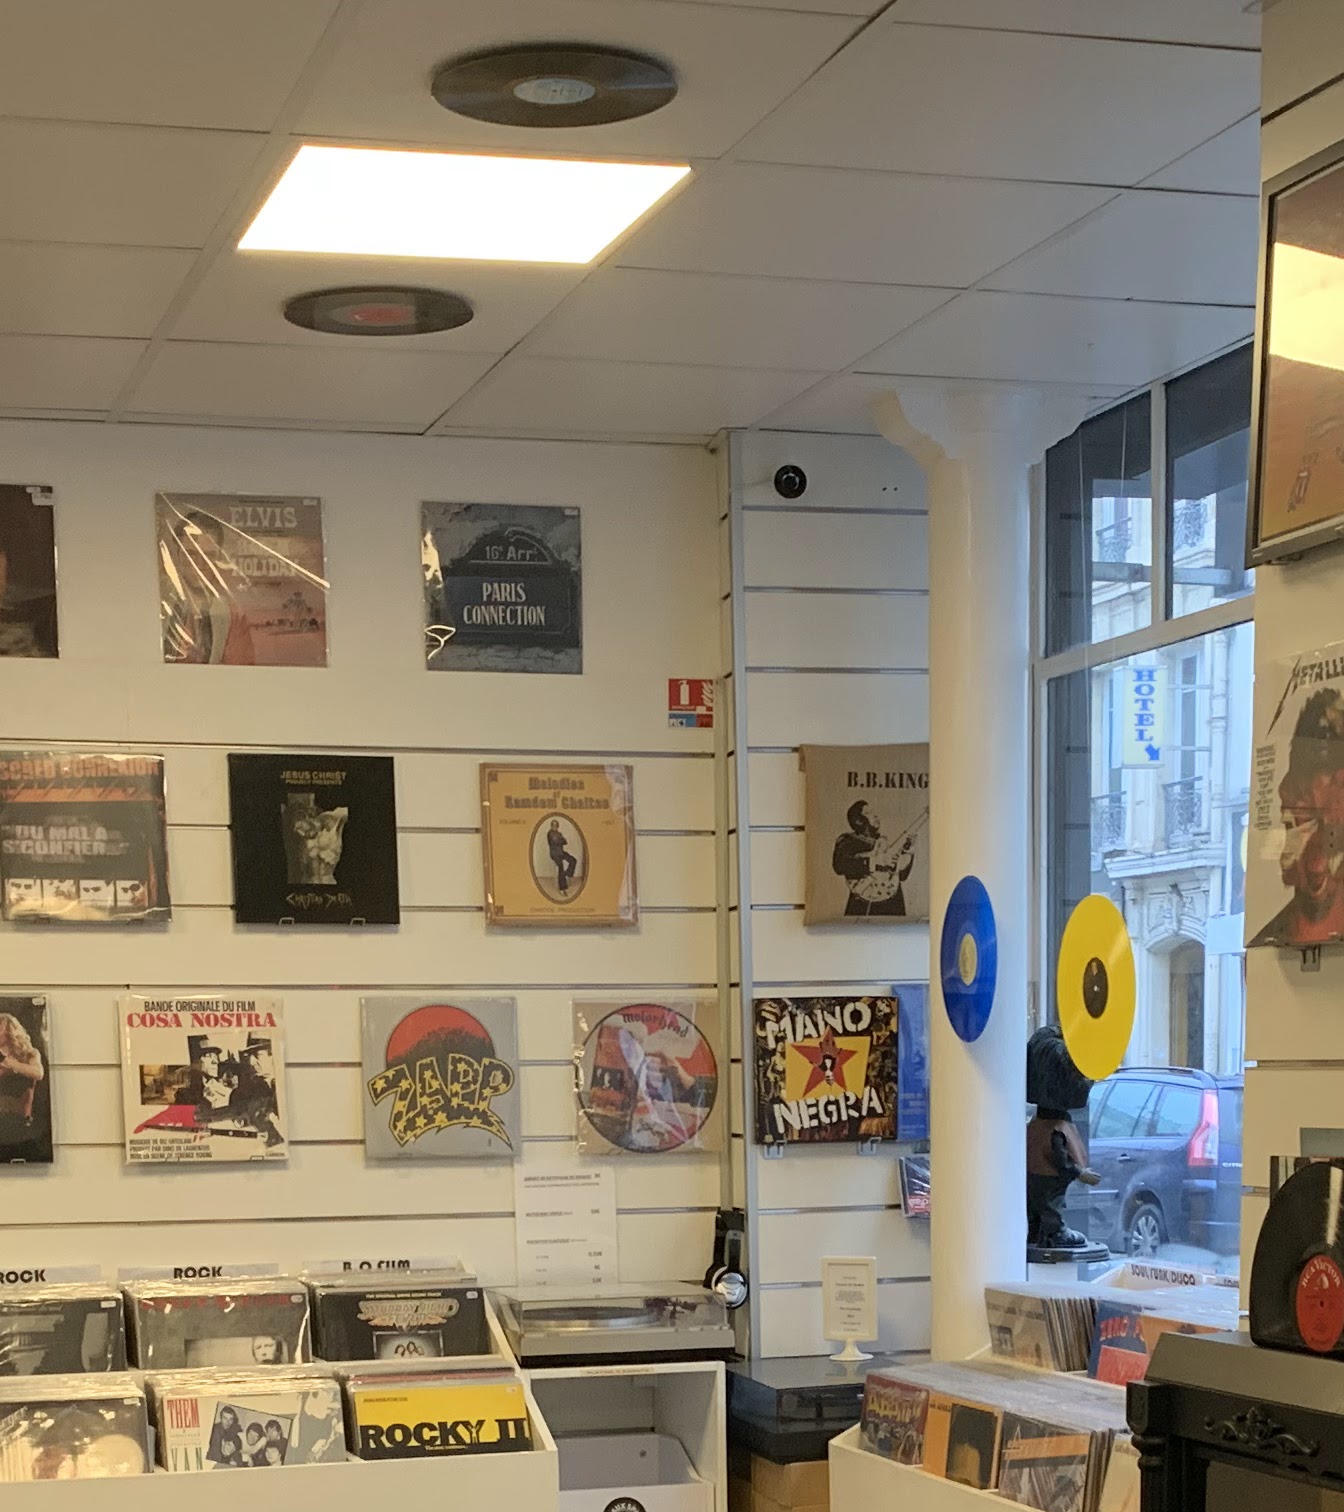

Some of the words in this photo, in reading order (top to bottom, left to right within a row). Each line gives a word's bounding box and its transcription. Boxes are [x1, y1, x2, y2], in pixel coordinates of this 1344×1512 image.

[229, 506, 298, 528] ELVIS
[482, 582, 526, 602] PARIS
[463, 605, 546, 626] CONNECTION
[1133, 669, 1157, 742] HOTEL
[280, 771, 311, 780] JESUS
[312, 772, 347, 781] CHRIST
[847, 770, 930, 790] B.B.KING
[144, 1001, 174, 1012] BANDE
[175, 1001, 221, 1012] ORIGINALE
[222, 1001, 234, 1012] DU
[236, 1001, 256, 1012] FILM
[126, 1012, 183, 1028] COSA
[190, 1012, 277, 1028] NOSTRA
[765, 1002, 872, 1050] MANO
[367, 1053, 515, 1151] ZAPP
[773, 1086, 884, 1134] NEGRA
[173, 1265, 222, 1280] ROCK
[167, 1398, 200, 1429] THEM
[359, 1419, 486, 1450] ROCKY
[494, 1417, 529, 1442] II
[171, 1448, 204, 1472] VAN
